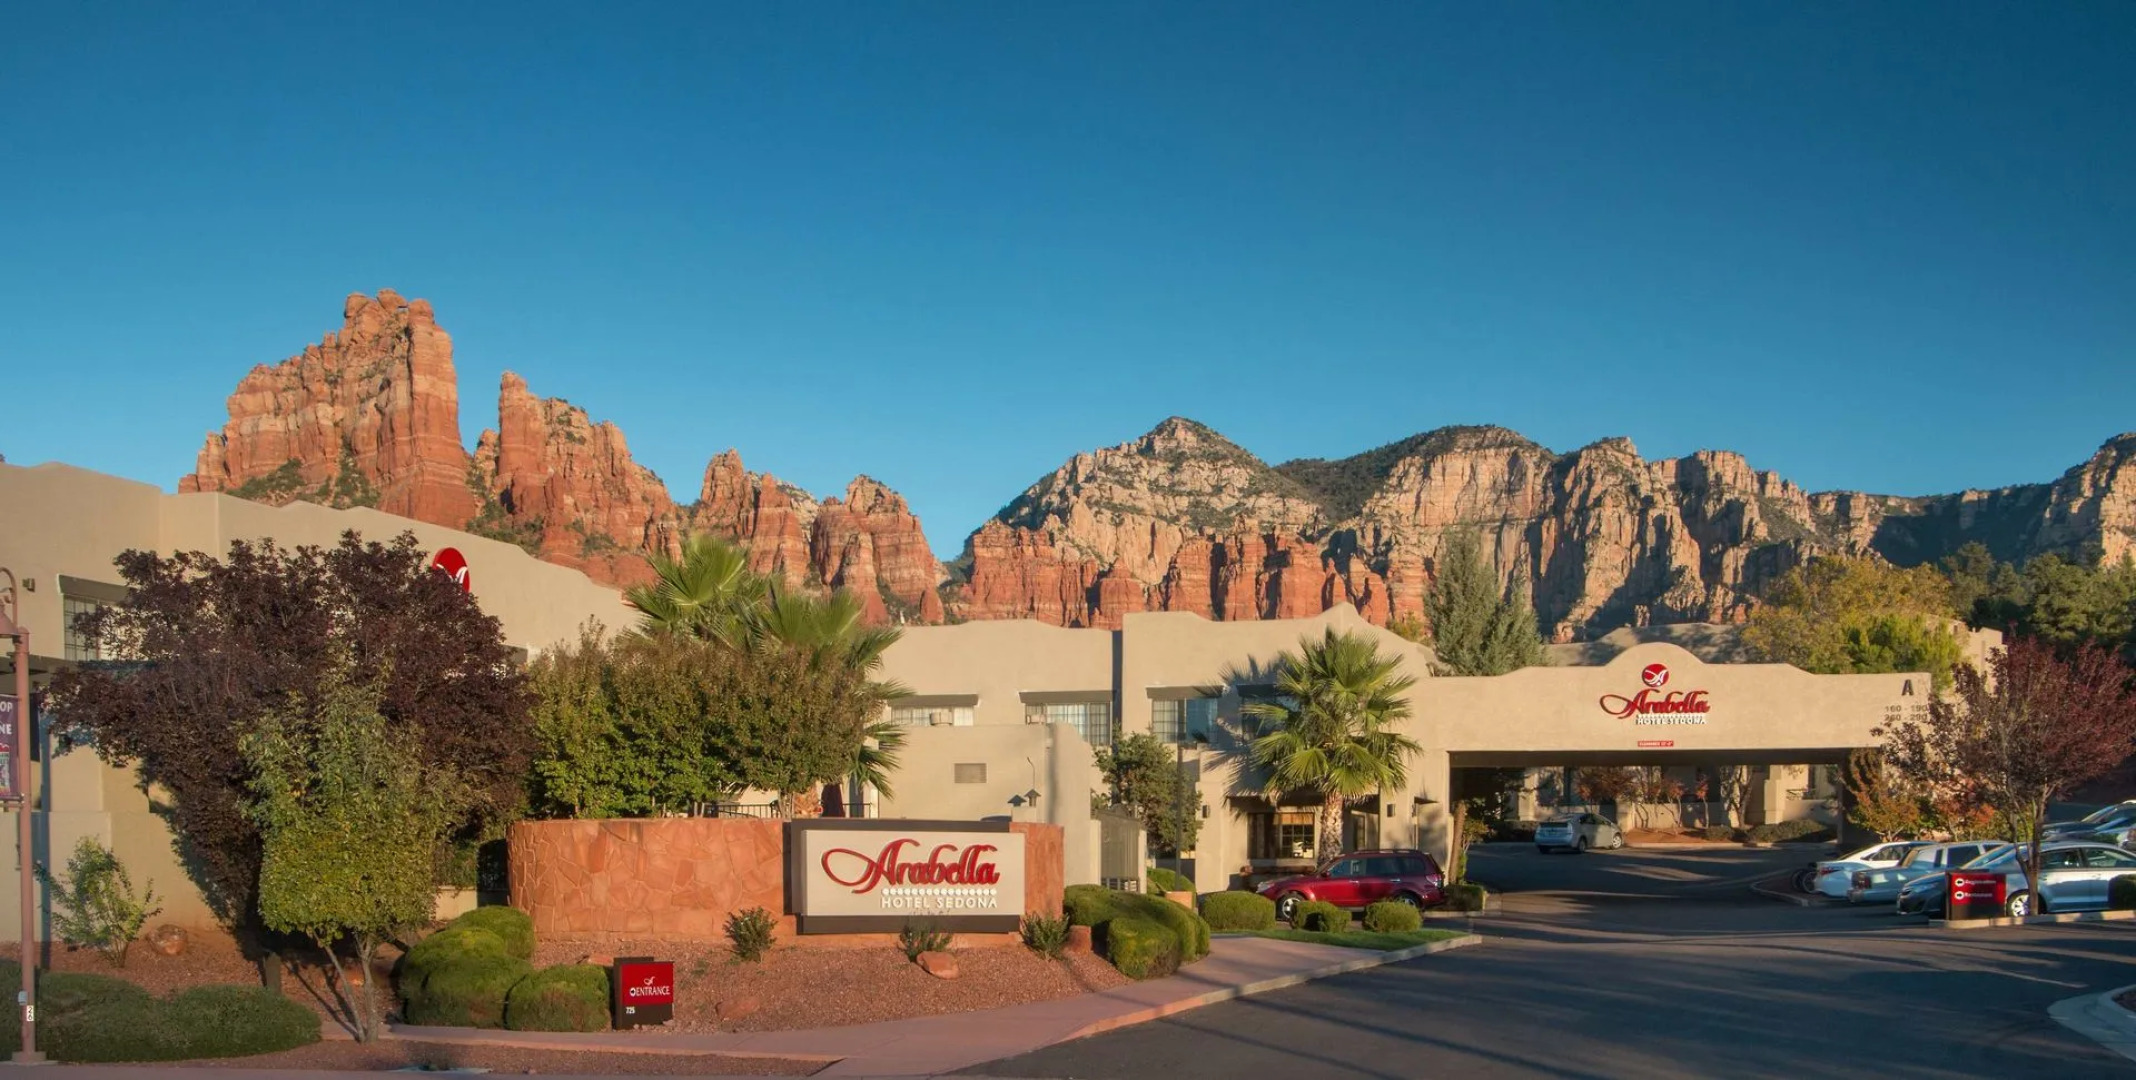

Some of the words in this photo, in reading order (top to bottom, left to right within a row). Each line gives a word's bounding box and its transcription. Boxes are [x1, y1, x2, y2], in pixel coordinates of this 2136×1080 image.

[1901, 679, 1914, 696] A
[0, 701, 13, 712] OP
[1600, 688, 1711, 719] Arabella
[0, 723, 12, 734] NE
[821, 838, 1000, 894] Arabella
[881, 897, 930, 909] HOTEL
[936, 897, 998, 909] SEDONA
[635, 985, 671, 996] ENTRANCE
